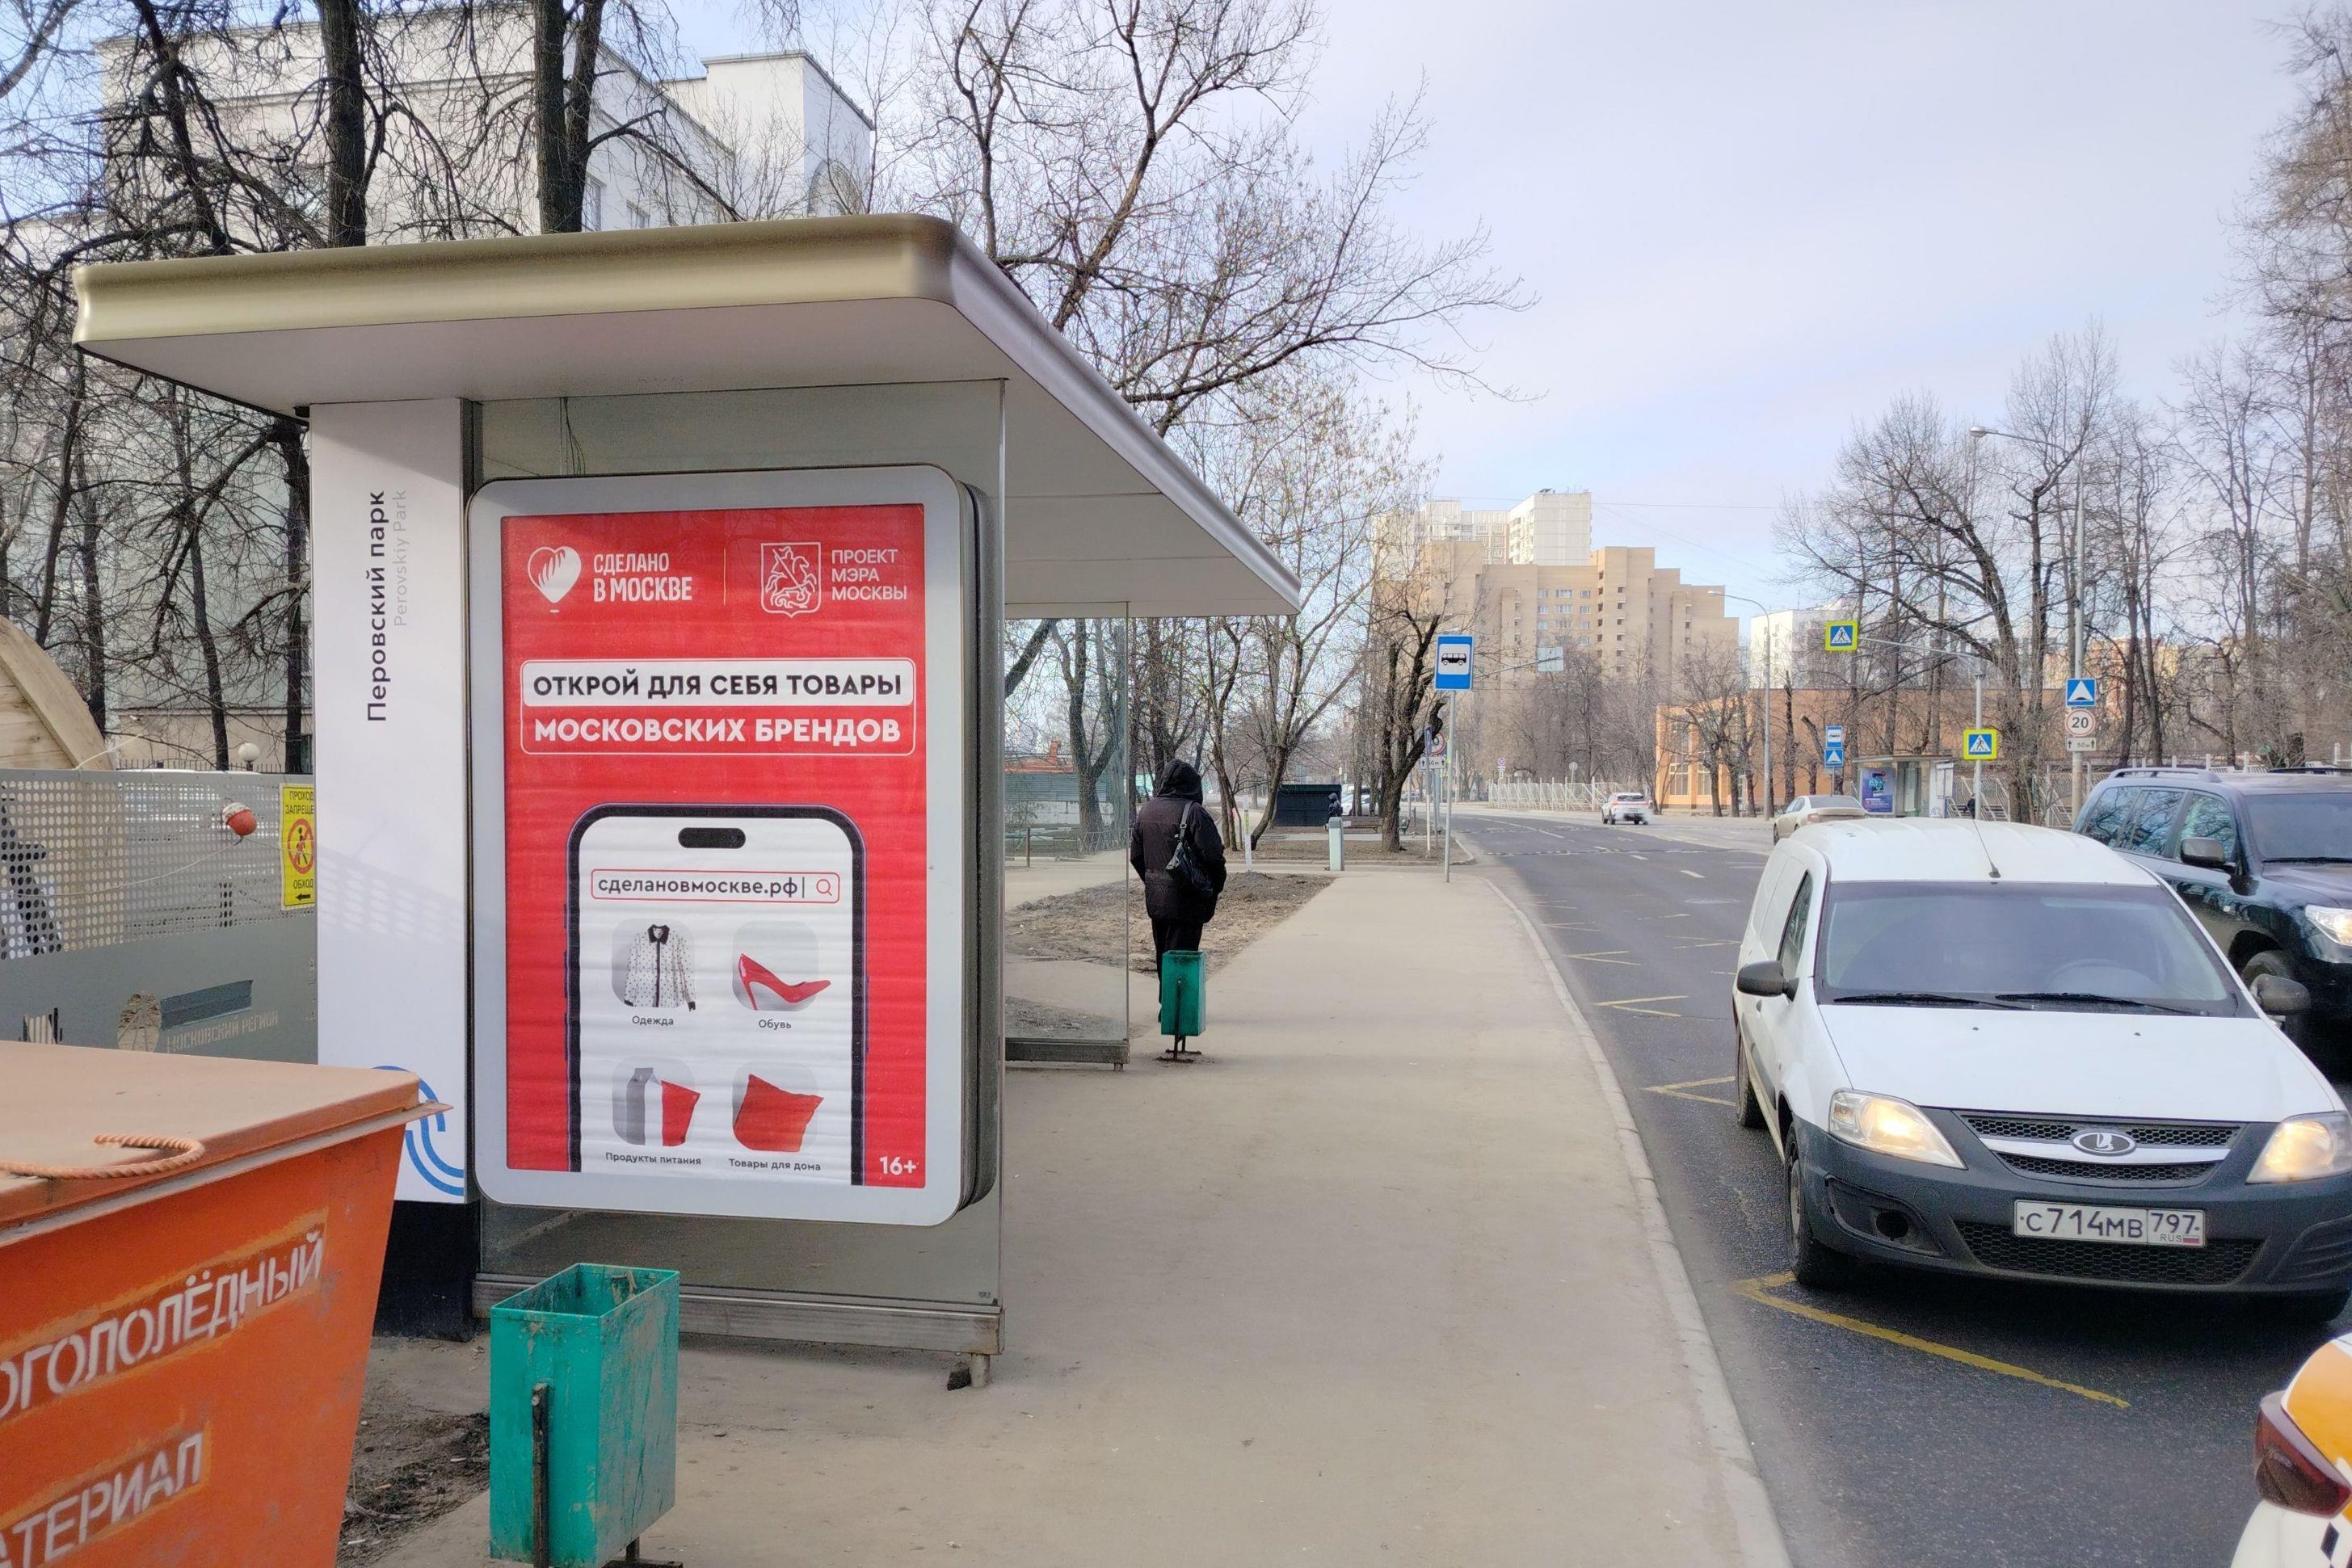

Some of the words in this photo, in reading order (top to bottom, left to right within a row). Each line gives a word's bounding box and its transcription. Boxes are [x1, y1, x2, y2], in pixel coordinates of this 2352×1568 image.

[392, 490, 406, 532] Park
[370, 490, 389, 557] парк
[593, 552, 670, 575] СДЕЛАНО
[831, 549, 898, 565] ПРОЕКТ
[392, 536, 410, 627] Perovskiy
[831, 568, 881, 583] МЭРА
[594, 579, 607, 603] В
[610, 576, 692, 602] МОСКВЕ
[831, 585, 907, 601] МОСКВЫ
[366, 567, 391, 721] Перовский
[533, 668, 639, 696] ОТКРОЙ
[647, 675, 701, 700] ДЛЯ
[709, 675, 778, 696] СЕБЯ
[787, 674, 902, 696] ТОВАРЫ
[534, 717, 747, 742] МОСКОВСКИХ
[755, 718, 902, 746] БРЕНДОВ
[2072, 717, 2089, 729] 20
[289, 790, 314, 801] ПРОХОД
[293, 878, 313, 889] ОБХОД
[598, 876, 797, 898] сделановмоскве.рф
[632, 1015, 674, 1026] Одежда
[758, 1019, 792, 1030] Обувь
[605, 1152, 657, 1165] Продукты
[659, 1156, 701, 1166] питания
[729, 1158, 768, 1170] Товары
[772, 1162, 791, 1171] для
[794, 1162, 822, 1171] дома
[878, 1156, 917, 1175] 16+
[2026, 1208, 2144, 1238] С714МВ
[2151, 1213, 2197, 1234] 797
[2160, 1234, 2183, 1242] RUS
